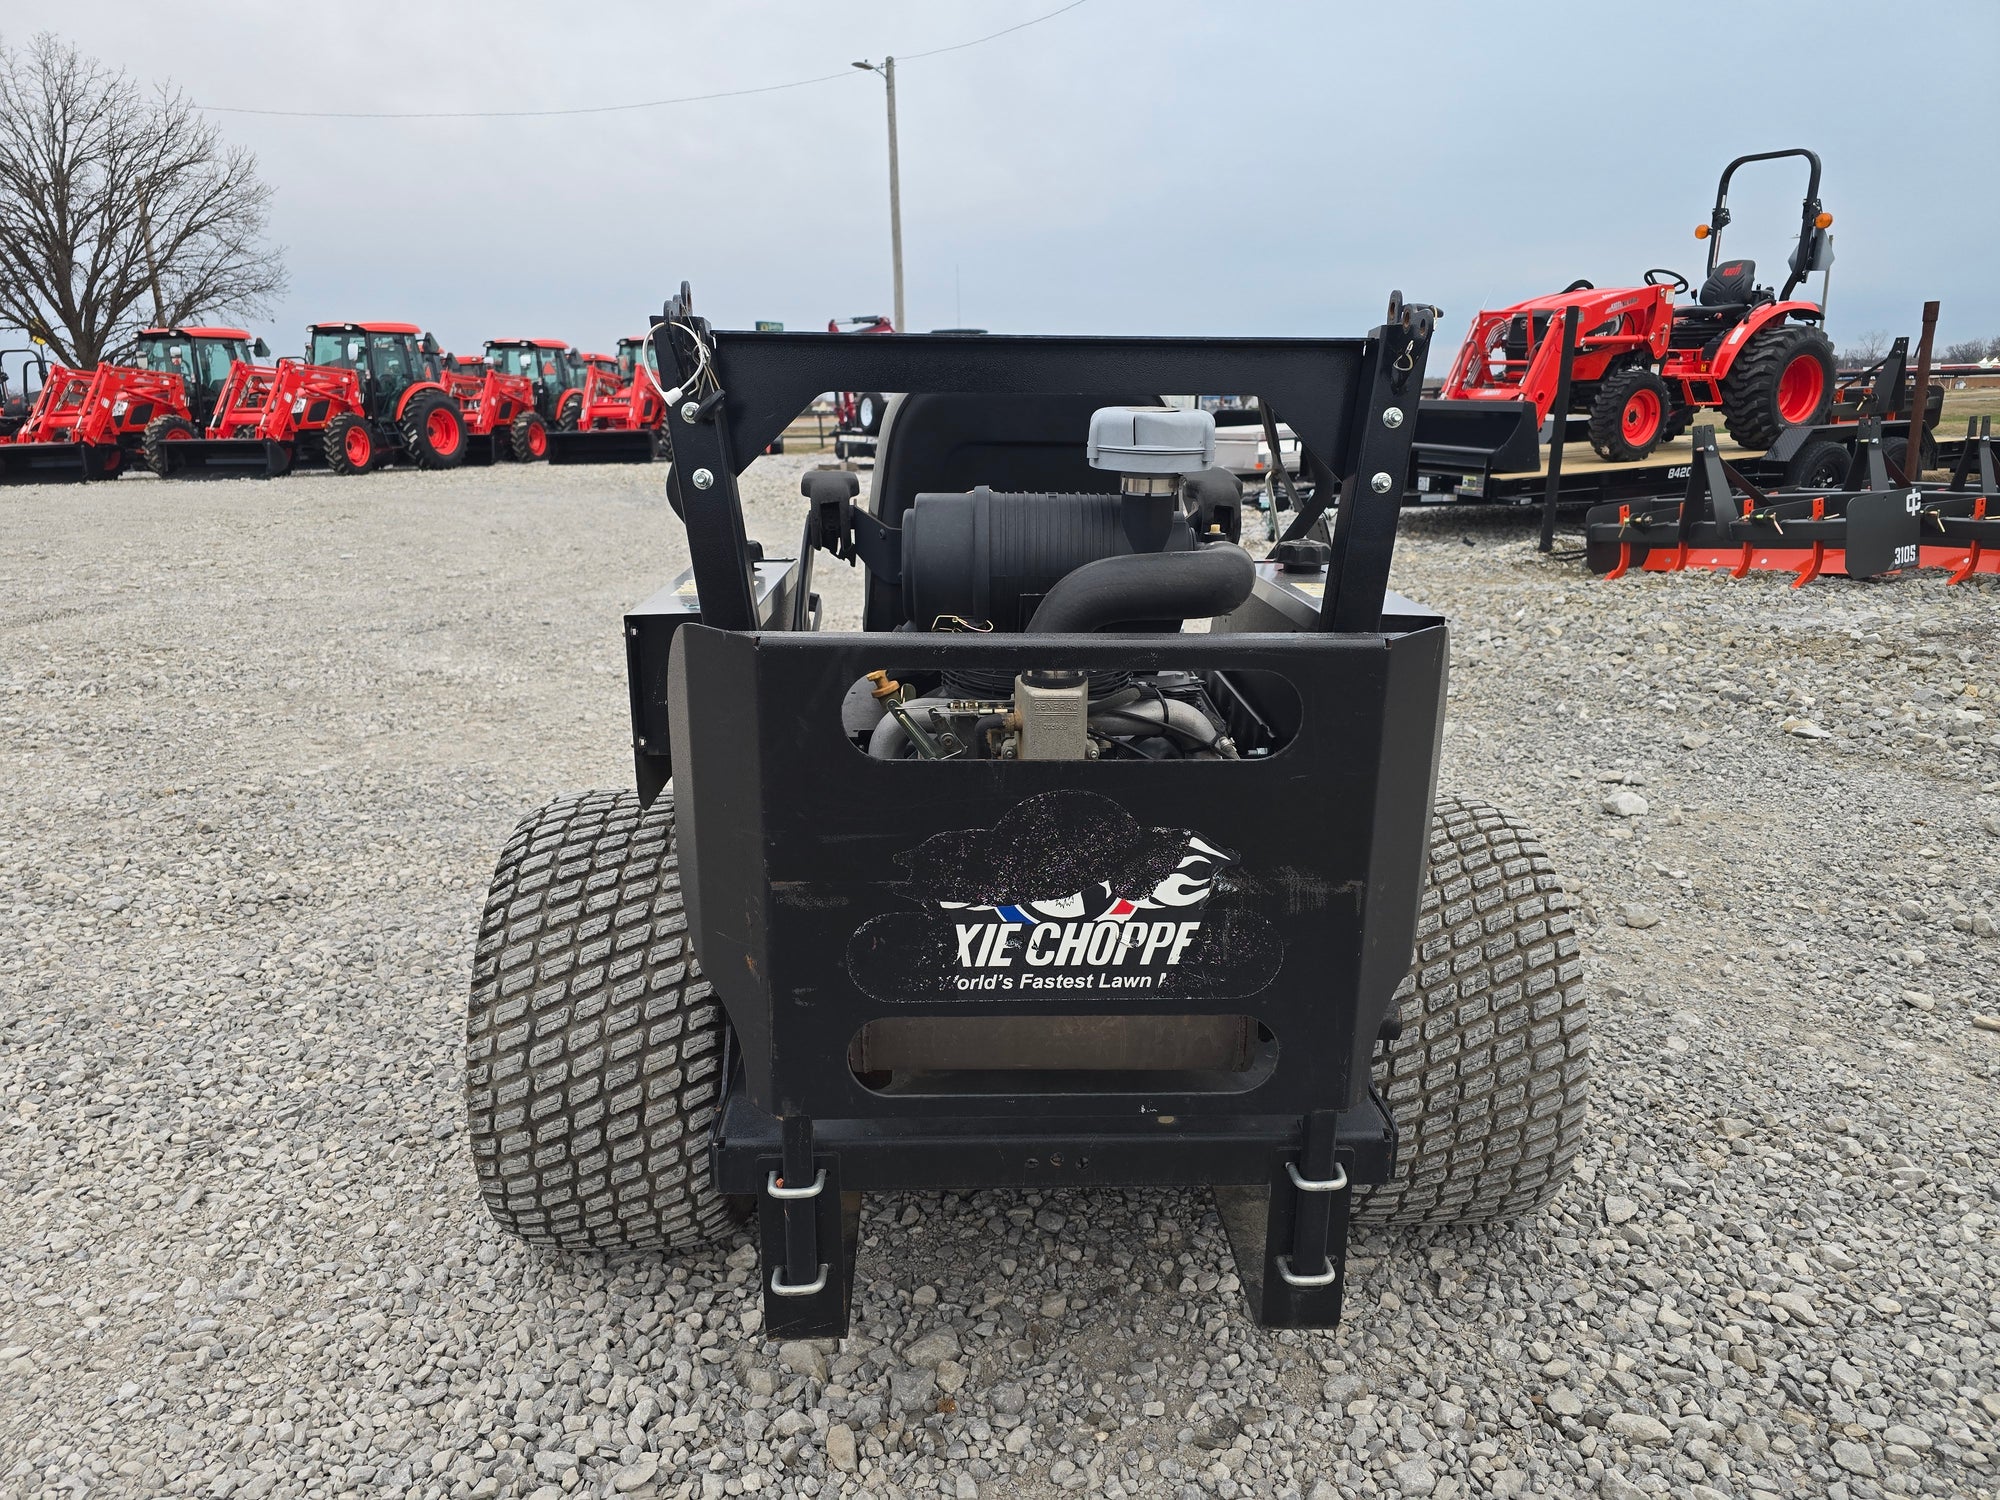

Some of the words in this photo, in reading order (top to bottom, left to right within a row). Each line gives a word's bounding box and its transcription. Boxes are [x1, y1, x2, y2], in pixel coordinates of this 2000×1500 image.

[953, 974, 1014, 991] orld's
[1019, 973, 1094, 989] Fastest
[1099, 971, 1152, 988] Lawn
